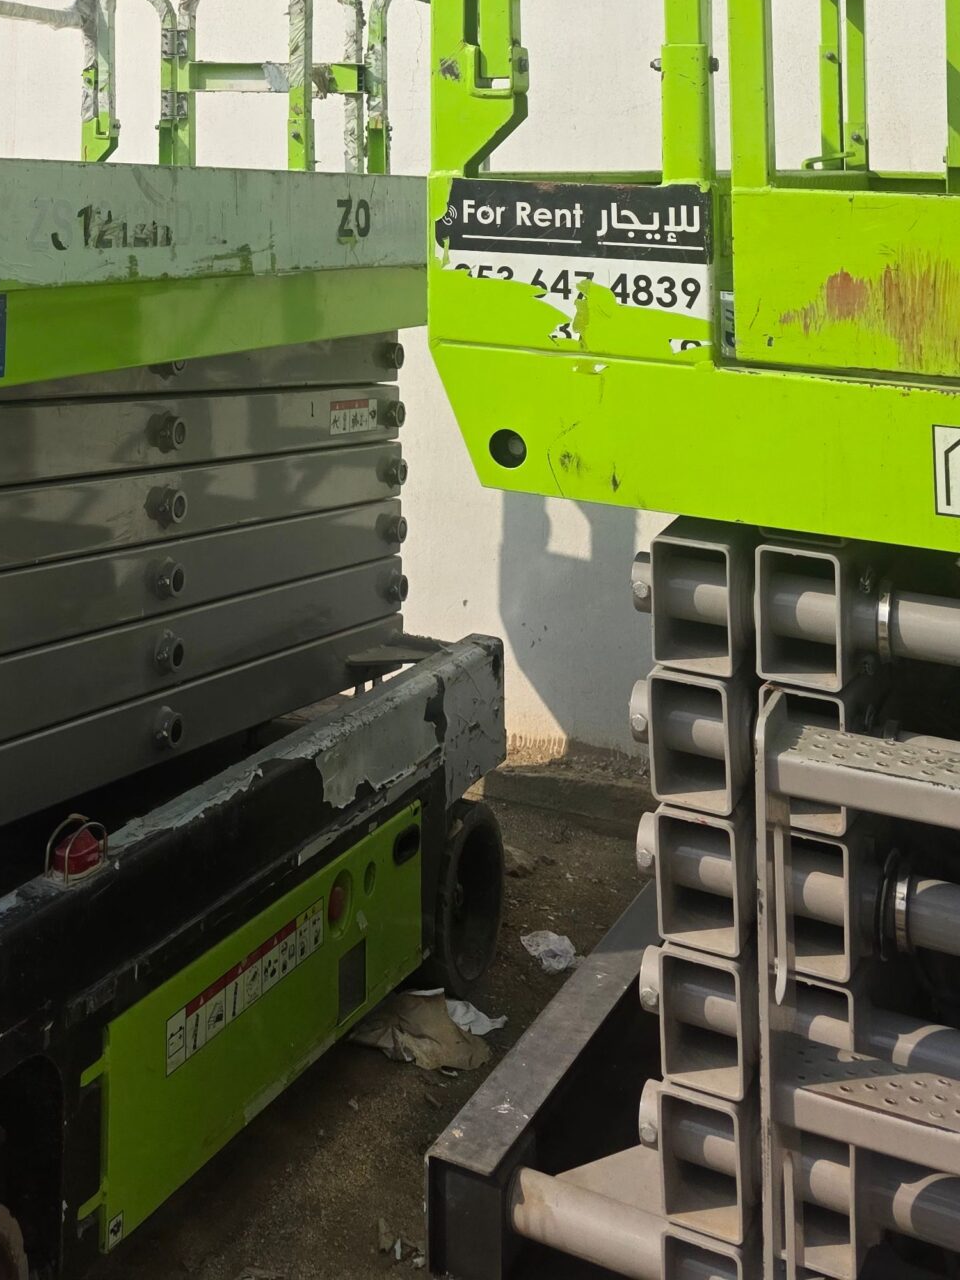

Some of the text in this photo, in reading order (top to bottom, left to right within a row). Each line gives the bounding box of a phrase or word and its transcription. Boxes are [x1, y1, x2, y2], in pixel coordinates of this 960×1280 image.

[462, 199, 584, 229] For Rent
[596, 202, 701, 243] للإيجار
[610, 272, 702, 310] 4839
